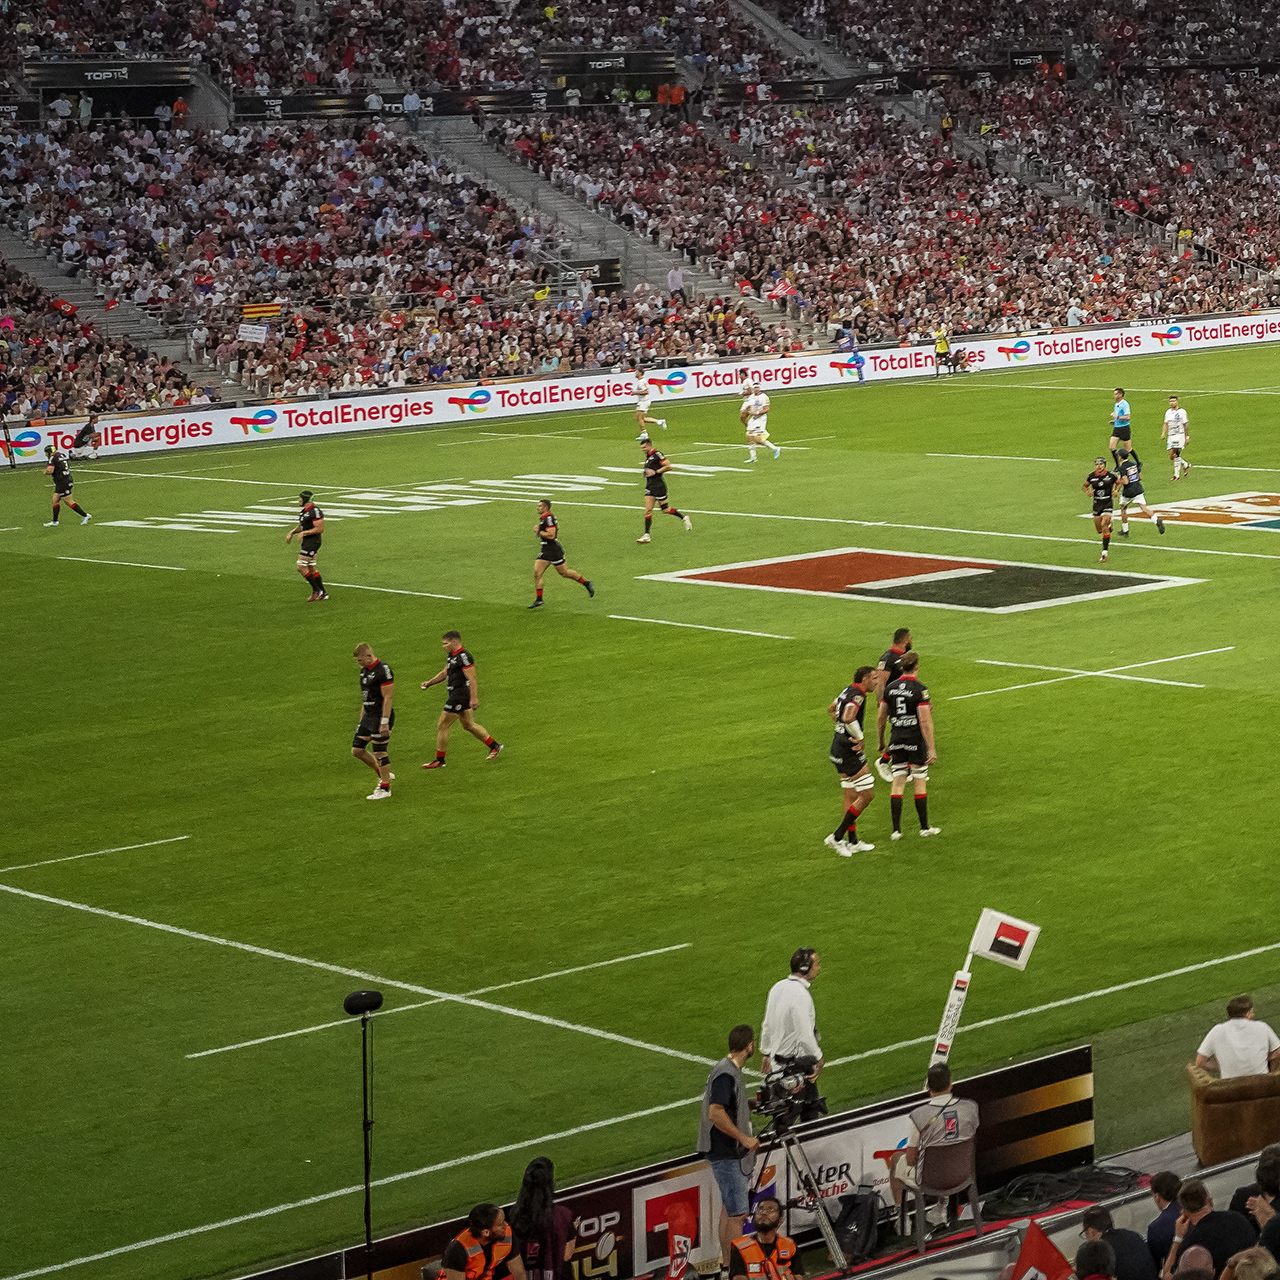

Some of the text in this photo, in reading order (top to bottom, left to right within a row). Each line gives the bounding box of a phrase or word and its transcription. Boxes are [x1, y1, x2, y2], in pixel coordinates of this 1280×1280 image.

[1034, 332, 1142, 357] TotalEnergies
[496, 380, 633, 407] TotalEnergies
[283, 399, 434, 428] TotalEnergies
[47, 419, 213, 450] TolEnergies
[896, 697, 907, 714] 5
[576, 1211, 621, 1237] OP
